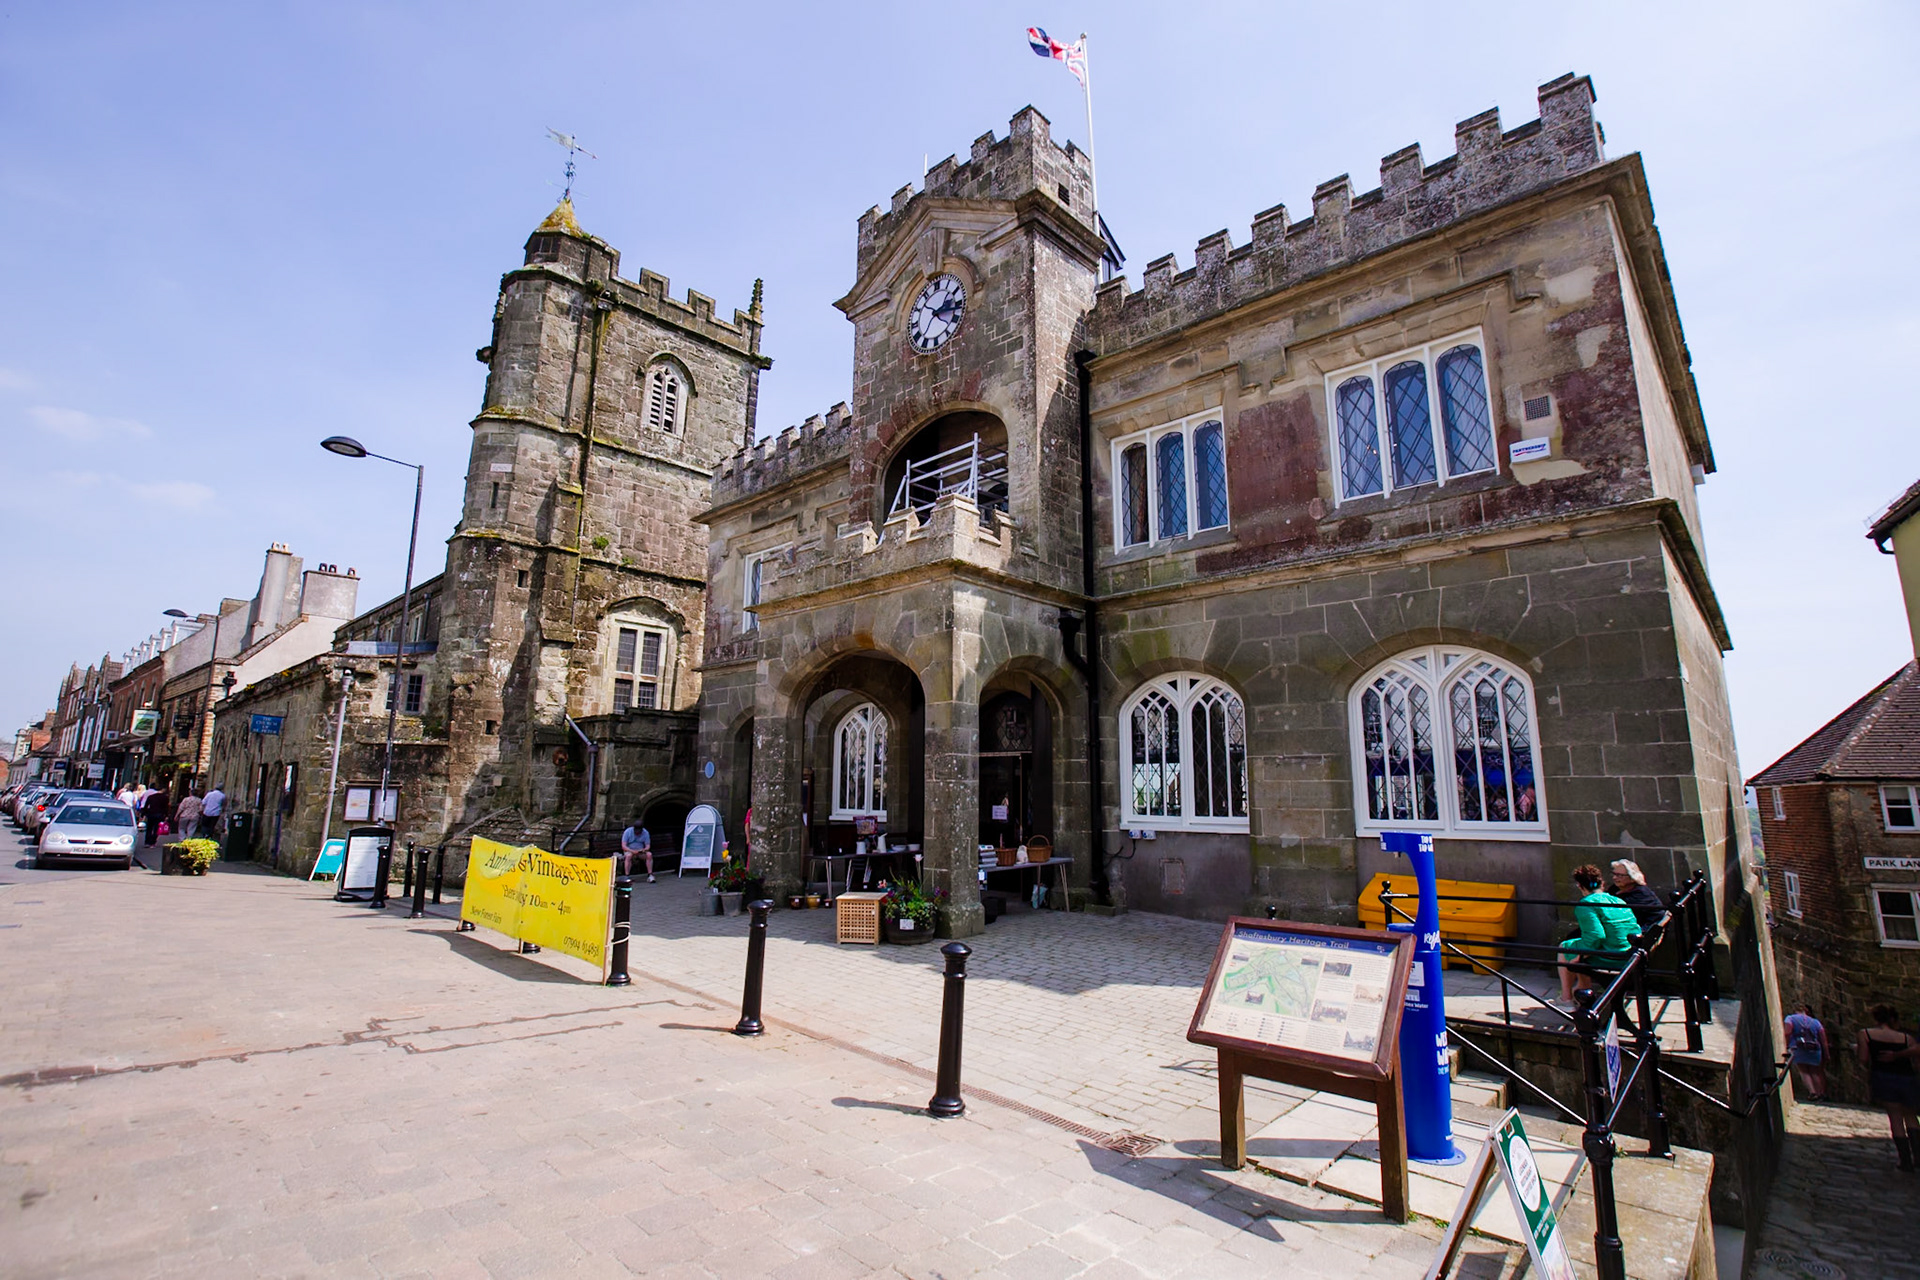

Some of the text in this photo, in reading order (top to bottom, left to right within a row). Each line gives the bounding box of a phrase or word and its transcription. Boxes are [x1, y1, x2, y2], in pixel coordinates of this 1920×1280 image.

[518, 852, 528, 873] &
[528, 853, 575, 886] Vintage
[574, 863, 599, 886] Fair
[529, 894, 548, 909] 10am
[557, 902, 571, 916] 4pm
[1238, 930, 1349, 949] Shaftesbury Heritage Trail
